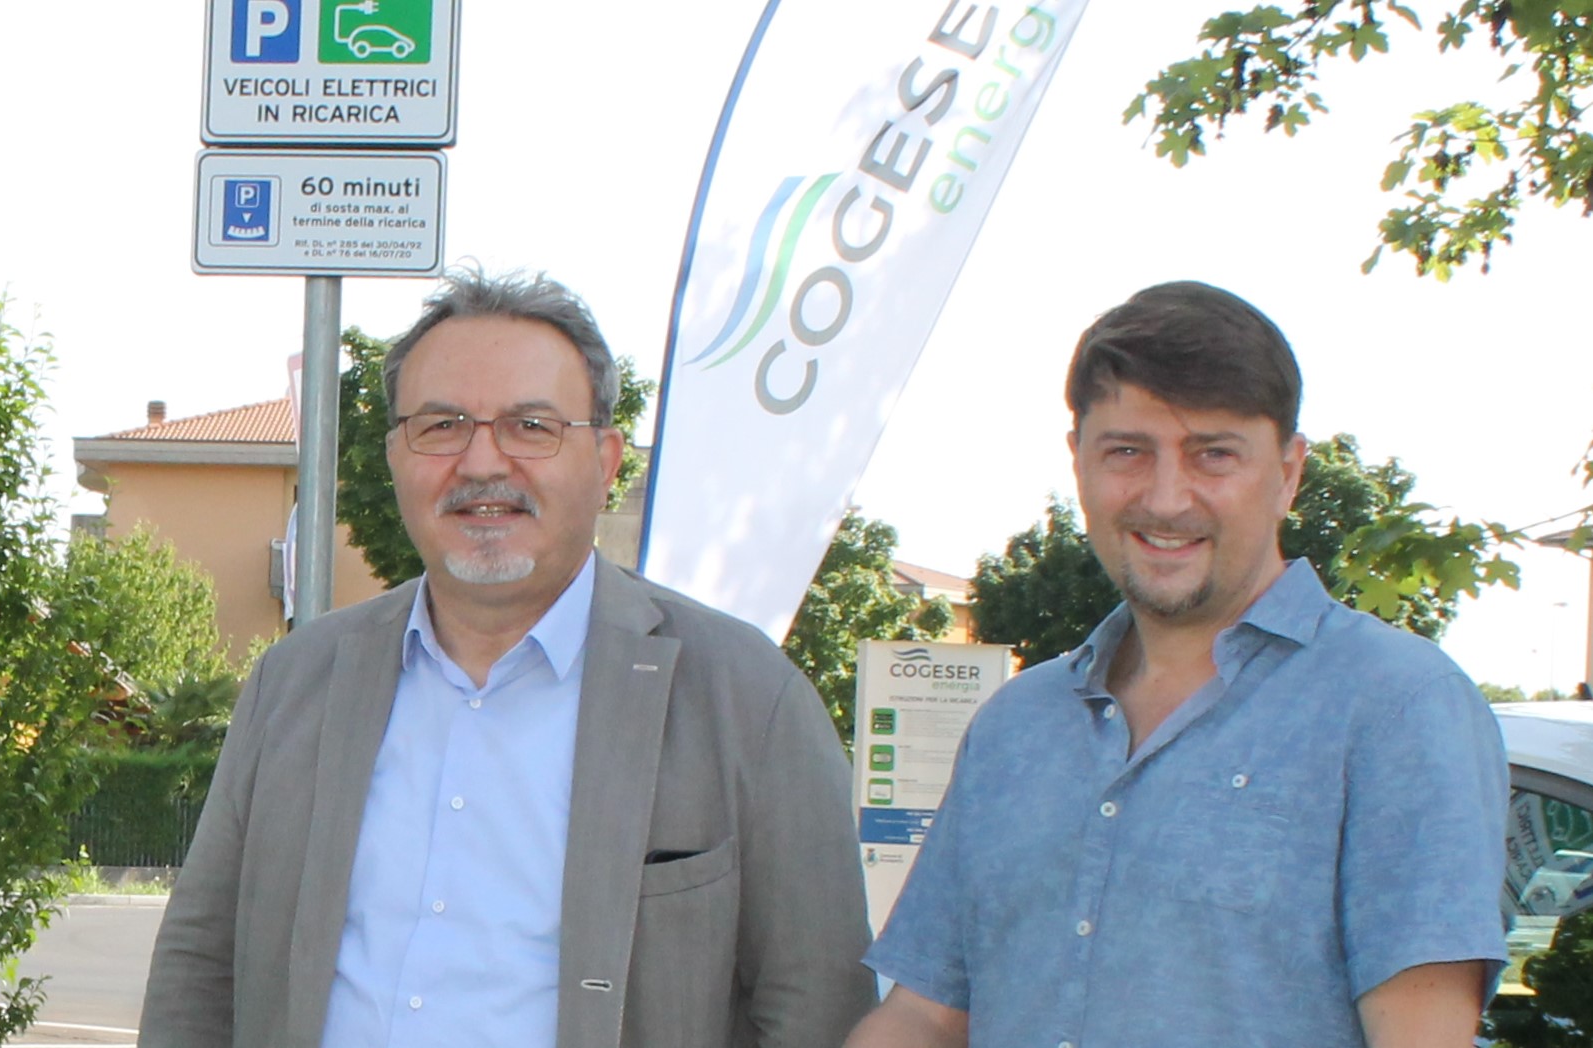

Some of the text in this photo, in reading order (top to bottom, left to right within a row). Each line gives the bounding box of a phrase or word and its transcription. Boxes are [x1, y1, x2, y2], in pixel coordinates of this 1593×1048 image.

[246, 0, 289, 57] P
[223, 78, 437, 98] VEICOLI ELETTRICI
[257, 104, 400, 123] IN RICARICA
[301, 177, 421, 197] 60 minuti
[310, 202, 409, 214] di sosta max. al
[293, 216, 426, 228] termine della ricarica
[889, 663, 980, 680] COGESER
